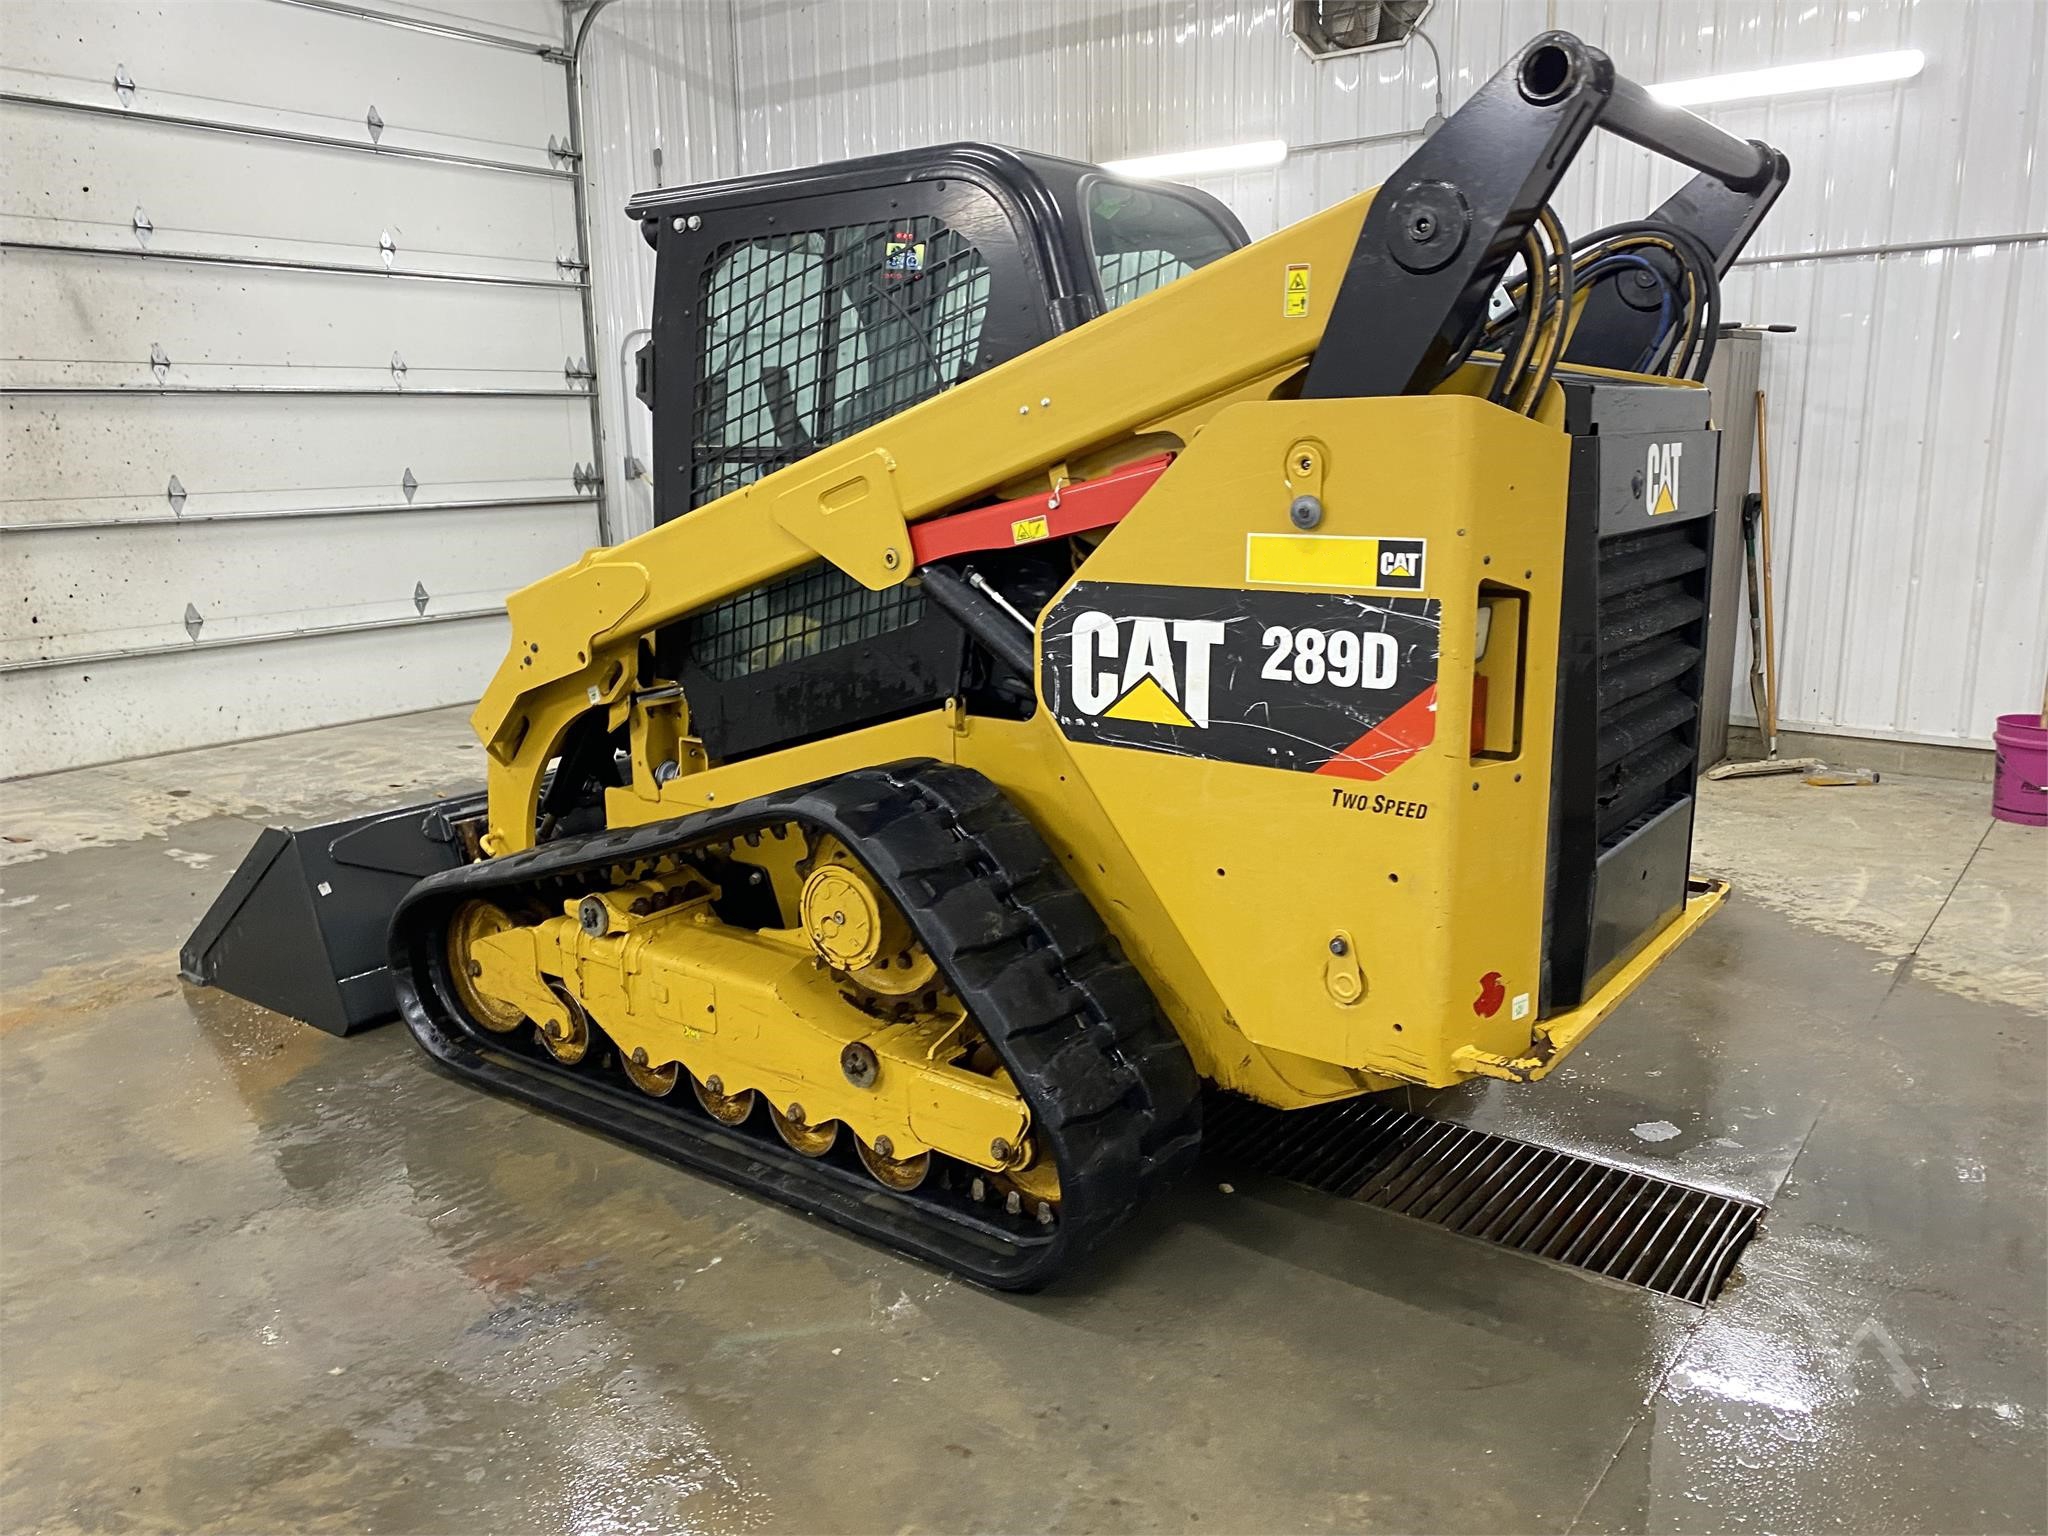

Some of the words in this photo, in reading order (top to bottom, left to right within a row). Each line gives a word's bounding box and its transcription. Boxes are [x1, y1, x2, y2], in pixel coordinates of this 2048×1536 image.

[1646, 442, 1682, 515] CAT
[1380, 551, 1421, 576] CAT
[1071, 610, 1225, 729] CAT
[1261, 625, 1399, 690] 289D
